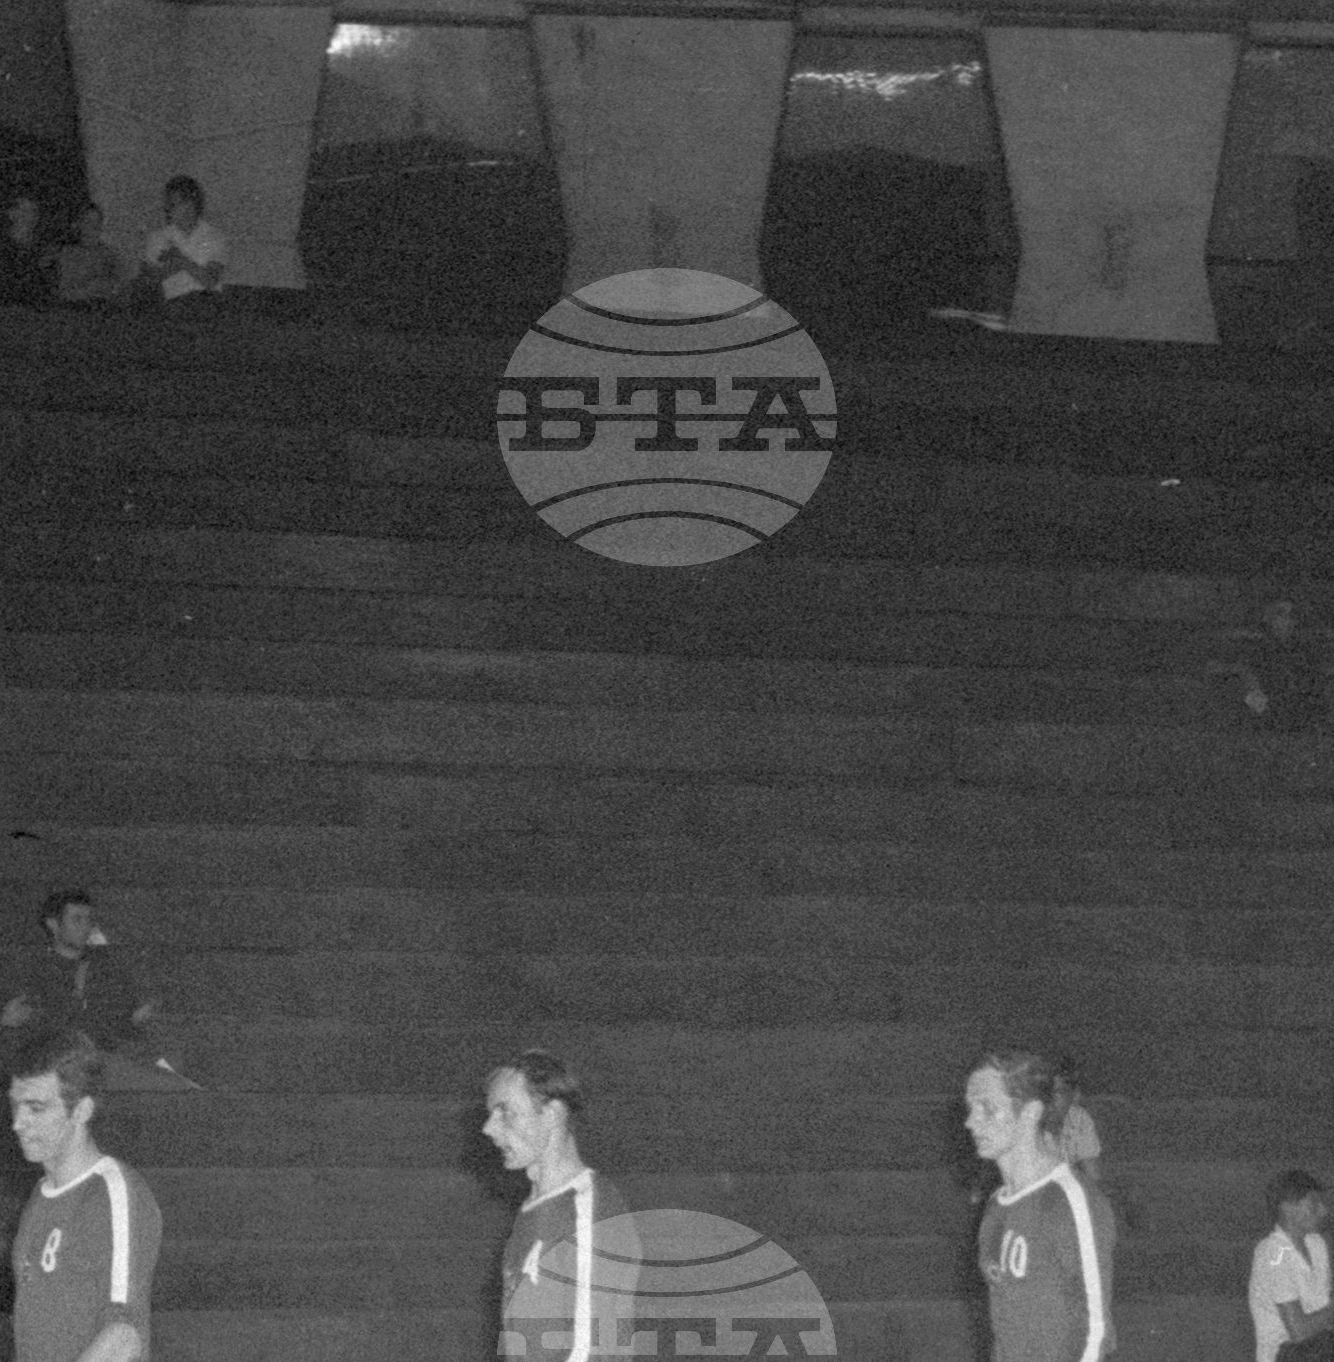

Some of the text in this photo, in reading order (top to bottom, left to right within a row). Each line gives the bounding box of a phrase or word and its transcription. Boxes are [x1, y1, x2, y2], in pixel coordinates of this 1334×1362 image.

[41, 1227, 62, 1273] 8
[522, 1239, 543, 1285] 4
[1000, 1229, 1027, 1278] 10
